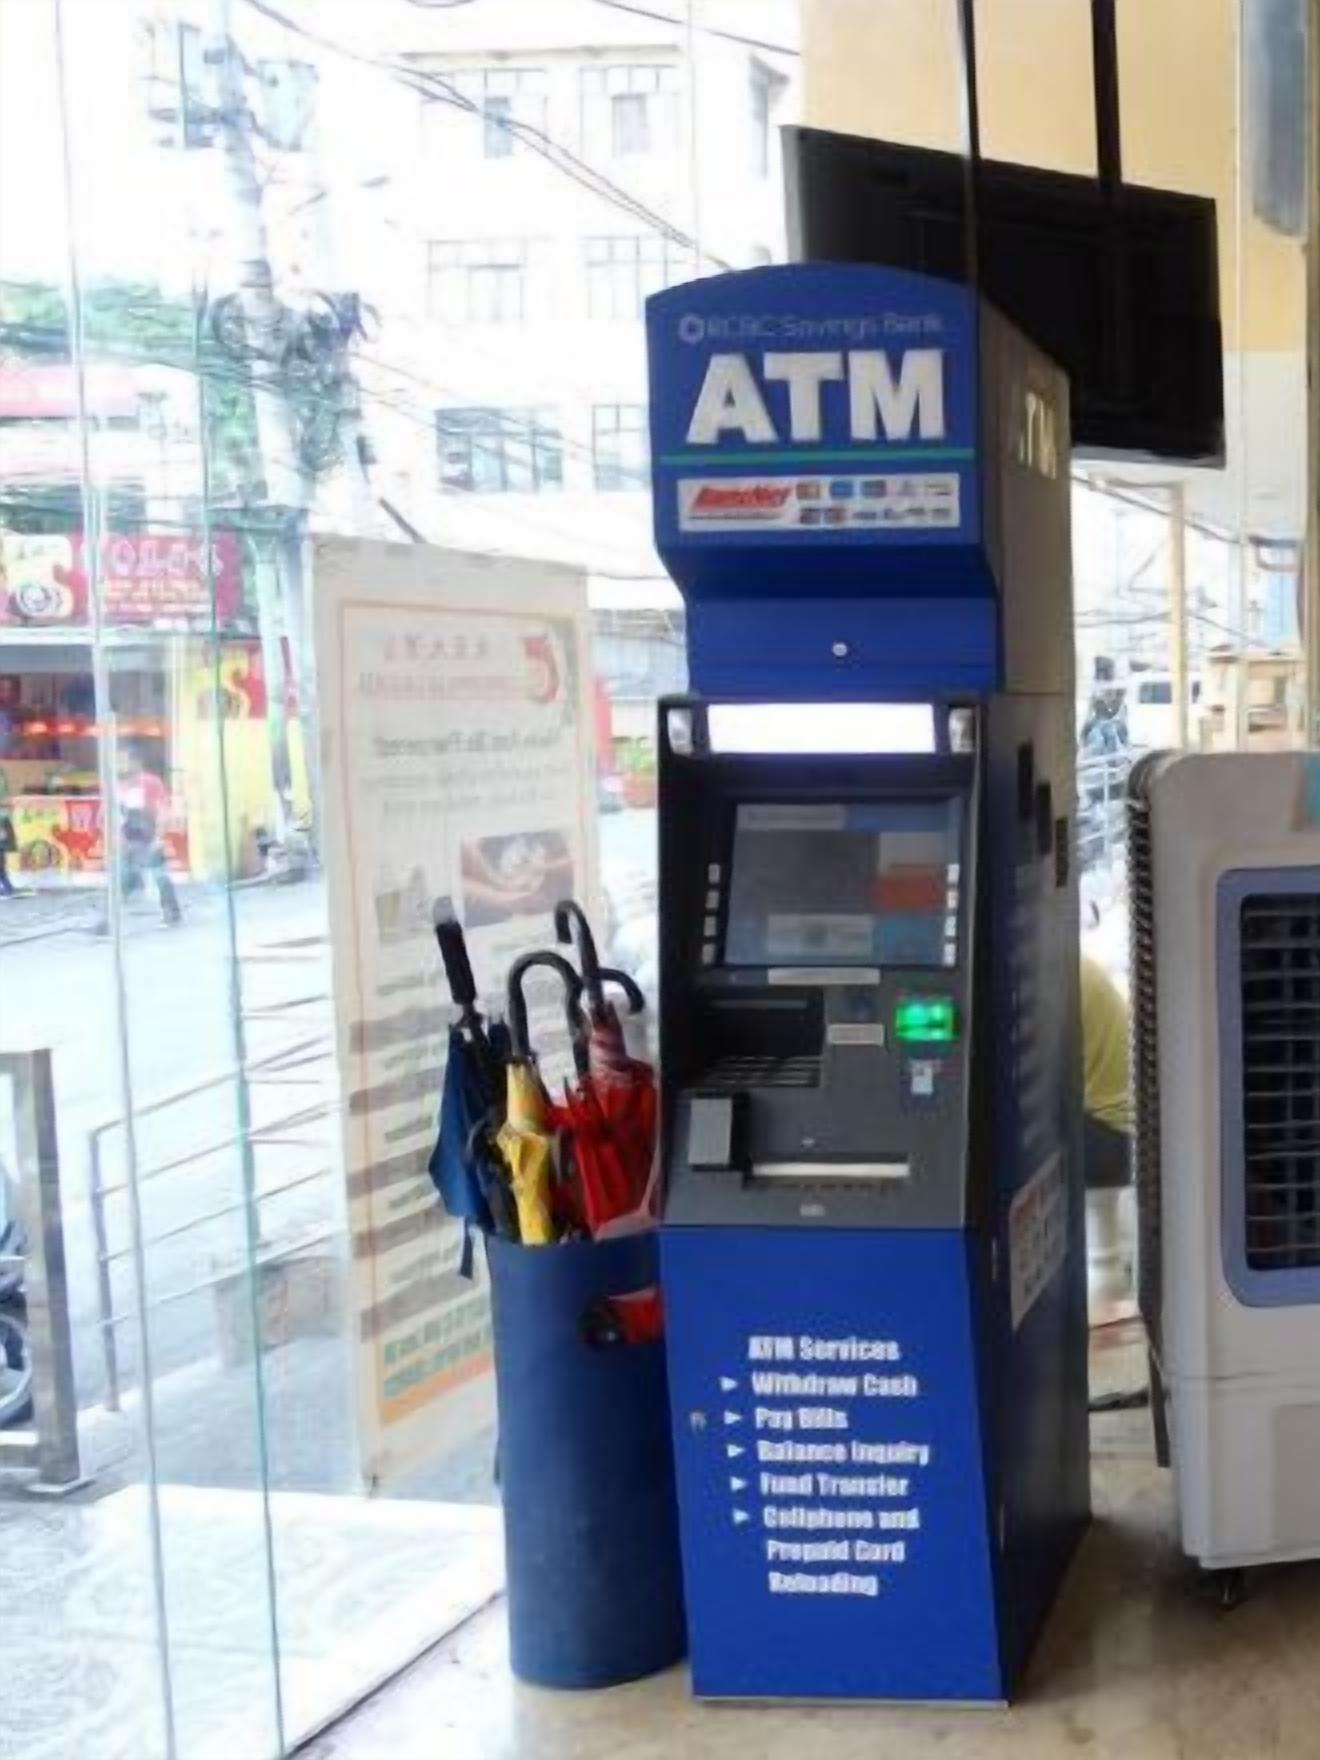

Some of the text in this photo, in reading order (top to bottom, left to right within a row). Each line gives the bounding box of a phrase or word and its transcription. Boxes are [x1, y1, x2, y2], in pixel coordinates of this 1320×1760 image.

[884, 313, 943, 335] Bank
[686, 349, 946, 444] ATM
[749, 1336, 900, 1361] ATM Services
[752, 1372, 918, 1397] Withdraw Cash
[756, 1407, 848, 1431] Pay Bills
[757, 1440, 930, 1466] Balance Inquiry
[760, 1472, 909, 1496] Fund Transfer
[763, 1505, 920, 1529] Cellphone and
[767, 1539, 905, 1563] Prepaid Card
[768, 1571, 879, 1597] Reloading
